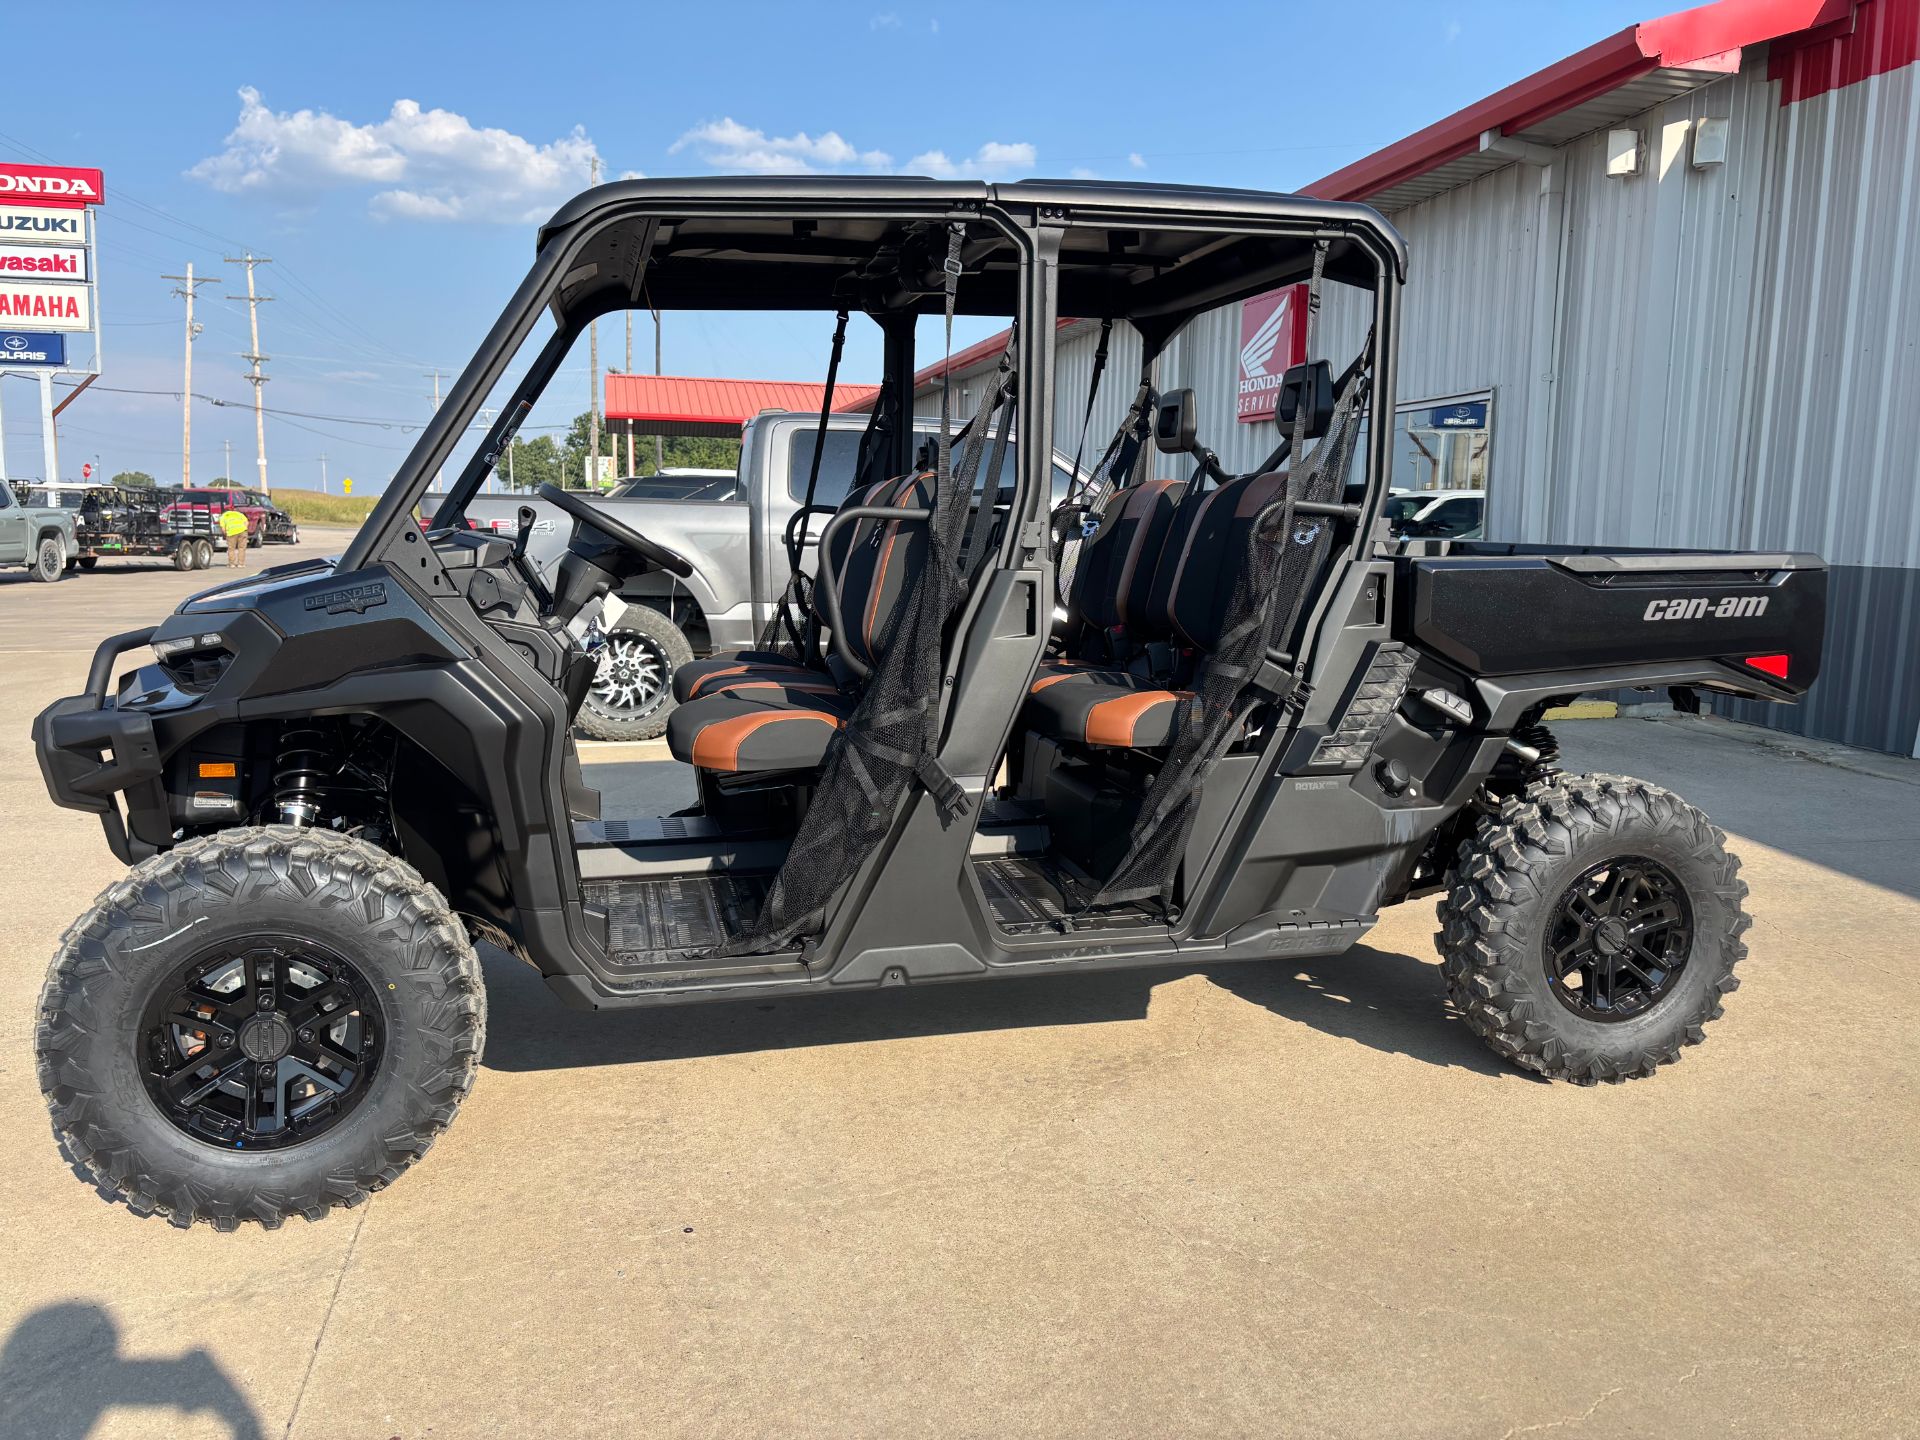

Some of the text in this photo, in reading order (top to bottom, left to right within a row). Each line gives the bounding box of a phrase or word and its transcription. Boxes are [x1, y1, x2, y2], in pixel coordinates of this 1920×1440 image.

[0, 215, 77, 233] UZUKI
[0, 293, 80, 318] AMAHA
[1239, 373, 1283, 393] HONDA
[305, 585, 381, 607] DEFENDER
